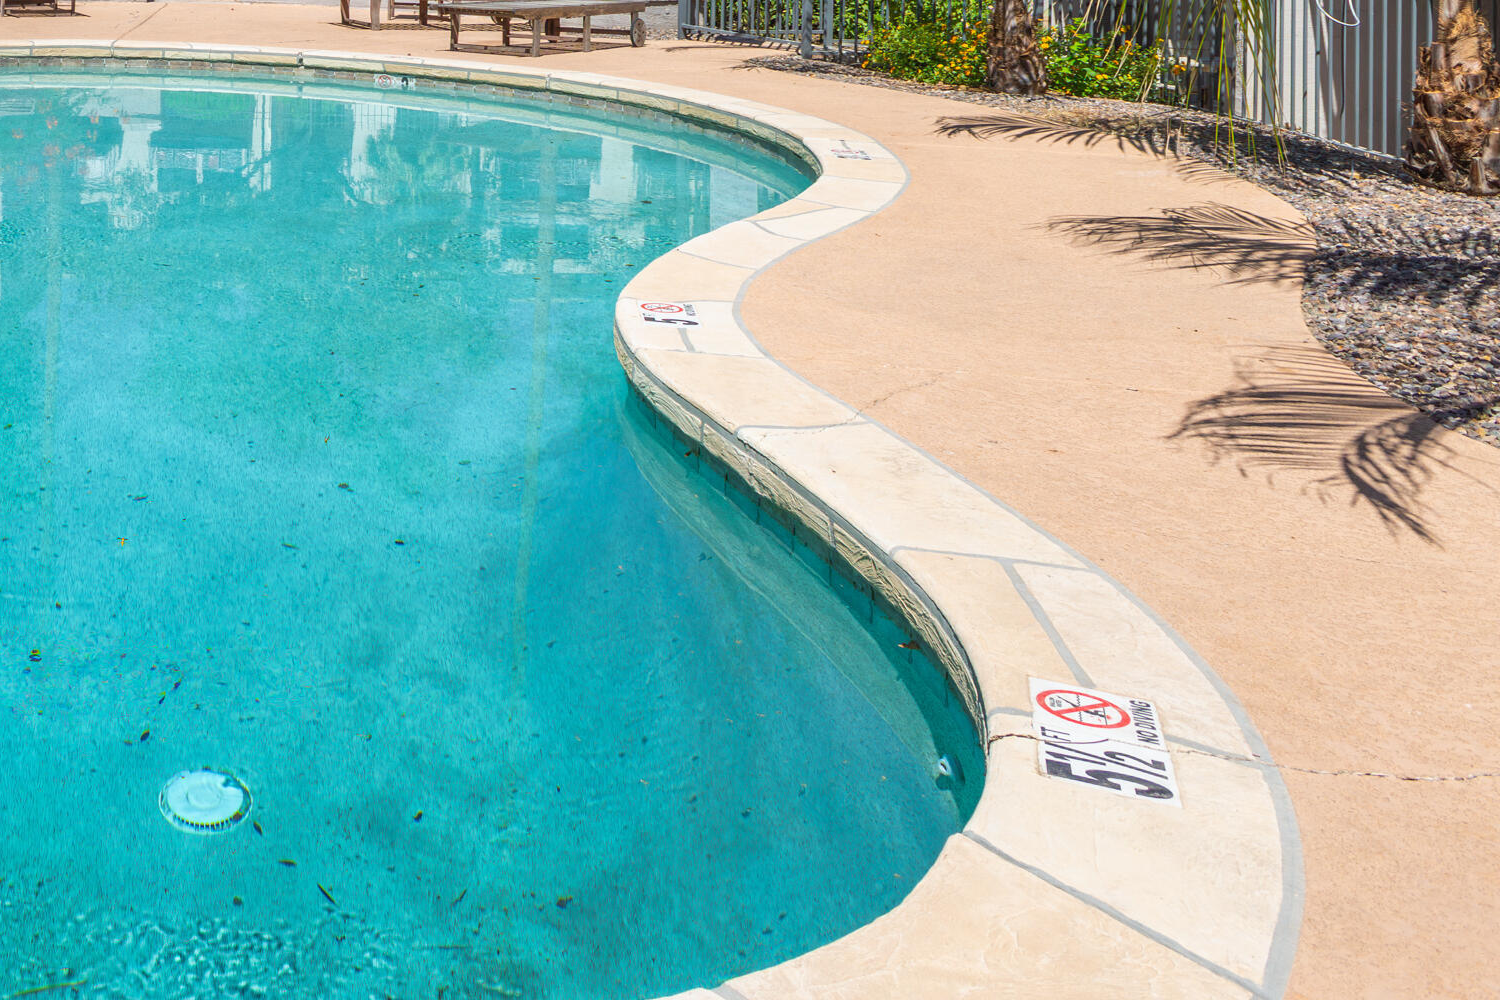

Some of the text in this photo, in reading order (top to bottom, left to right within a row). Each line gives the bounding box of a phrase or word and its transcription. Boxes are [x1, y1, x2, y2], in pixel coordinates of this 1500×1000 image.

[644, 316, 698, 325] 5
[1129, 700, 1160, 745] NO DIVING
[1040, 726, 1071, 742] FT
